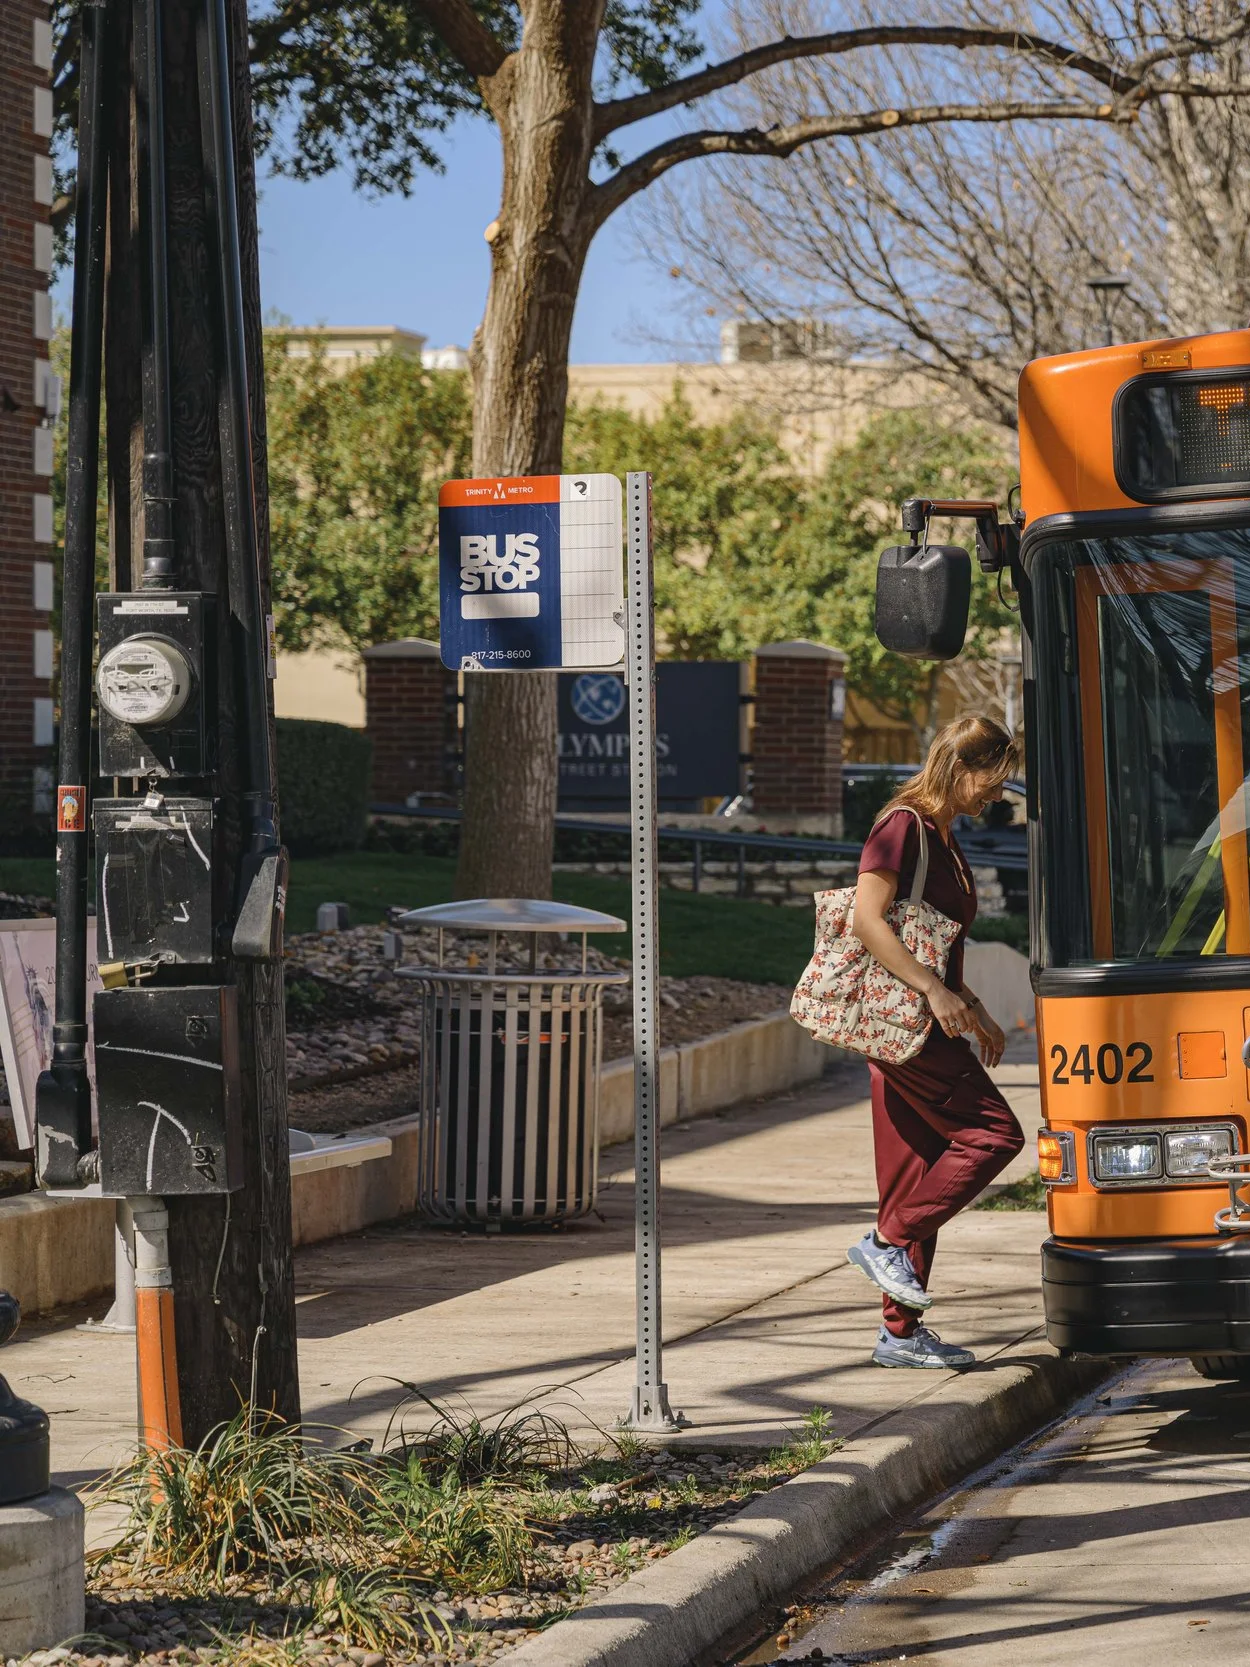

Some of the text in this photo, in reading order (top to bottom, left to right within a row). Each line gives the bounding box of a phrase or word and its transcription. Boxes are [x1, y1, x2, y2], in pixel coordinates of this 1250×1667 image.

[465, 486, 533, 496] TRINITY METRO
[460, 533, 540, 567] BUS
[460, 564, 540, 592] STOP
[471, 649, 531, 660] 817-215-8600
[557, 732, 670, 757] LYMPS
[560, 763, 607, 776] TREET
[1050, 1042, 1154, 1085] 2402
